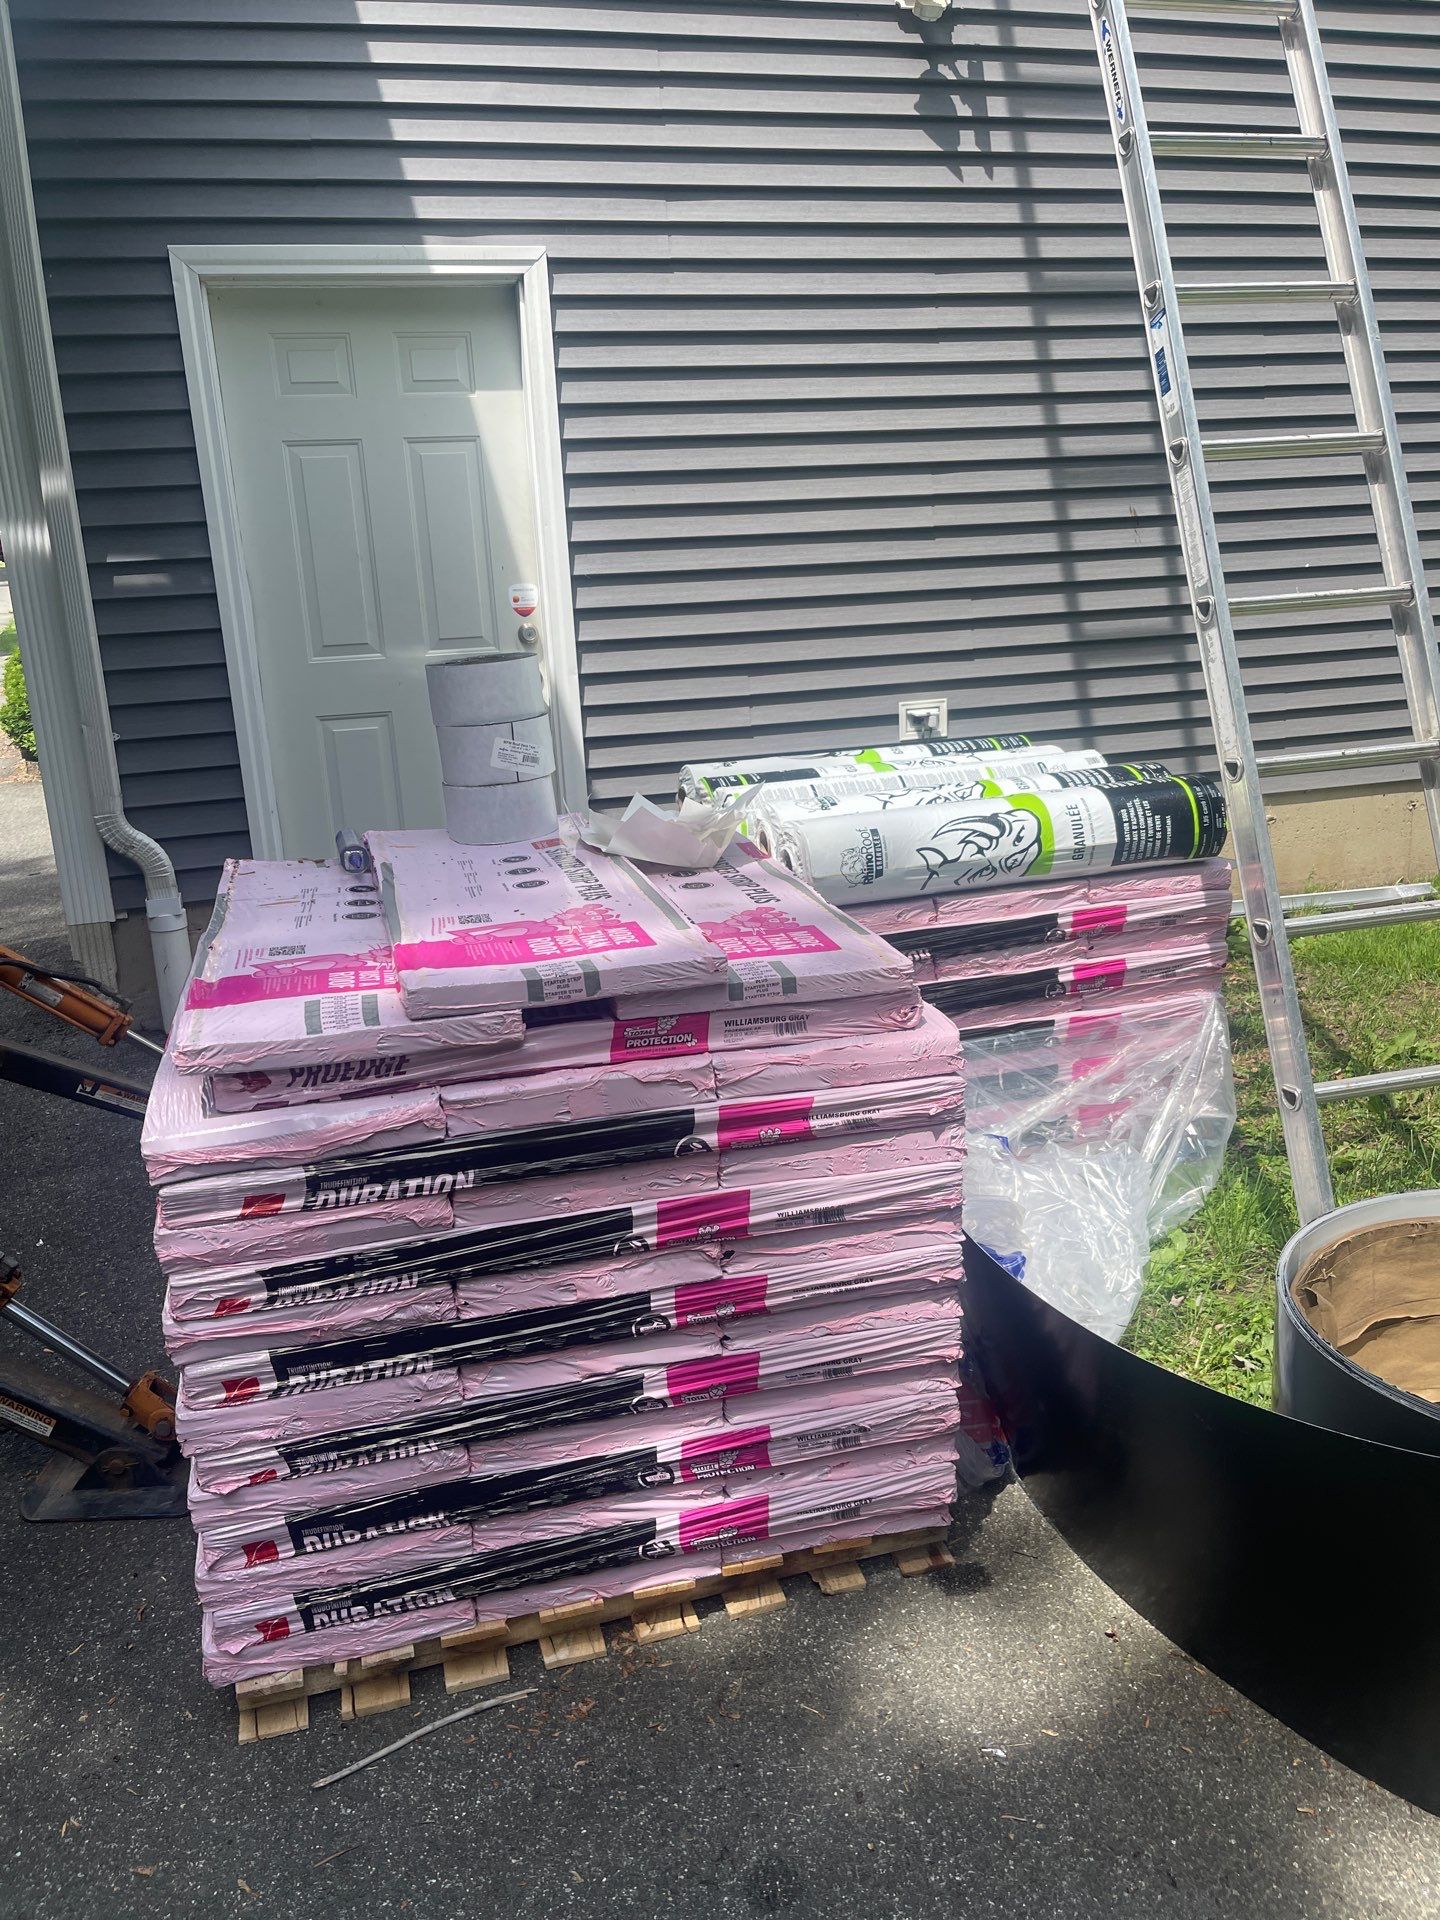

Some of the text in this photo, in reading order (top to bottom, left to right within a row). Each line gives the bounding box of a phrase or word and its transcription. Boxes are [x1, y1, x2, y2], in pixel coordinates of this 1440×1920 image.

[1105, 40, 1121, 101] WERNER
[1120, 808, 1129, 822] SOUS
[1154, 815, 1162, 831] FENTE
[1065, 803, 1086, 861] GRANULÉE
[1155, 831, 1162, 839] DE
[856, 827, 875, 885] RhinoRoof
[575, 883, 613, 901] PLUS
[741, 888, 781, 904] PLUS
[526, 936, 561, 956] ROOF
[763, 933, 799, 951] THAN
[328, 971, 356, 989] ROOF
[724, 1013, 810, 1028] WILLIAMSBURG GRAY
[626, 1033, 693, 1048] PROTECTION
[629, 1029, 654, 1037] TOTAL
[801, 1110, 861, 1122] WILLIAMSBURG
[312, 1169, 475, 1210] DURATION
[853, 1278, 874, 1287] GRAY
[844, 1357, 863, 1365] GRAY
[687, 1394, 708, 1403] TOTAL
[697, 1464, 756, 1480] PROTECTION
[697, 1535, 757, 1551] PROTECTION
